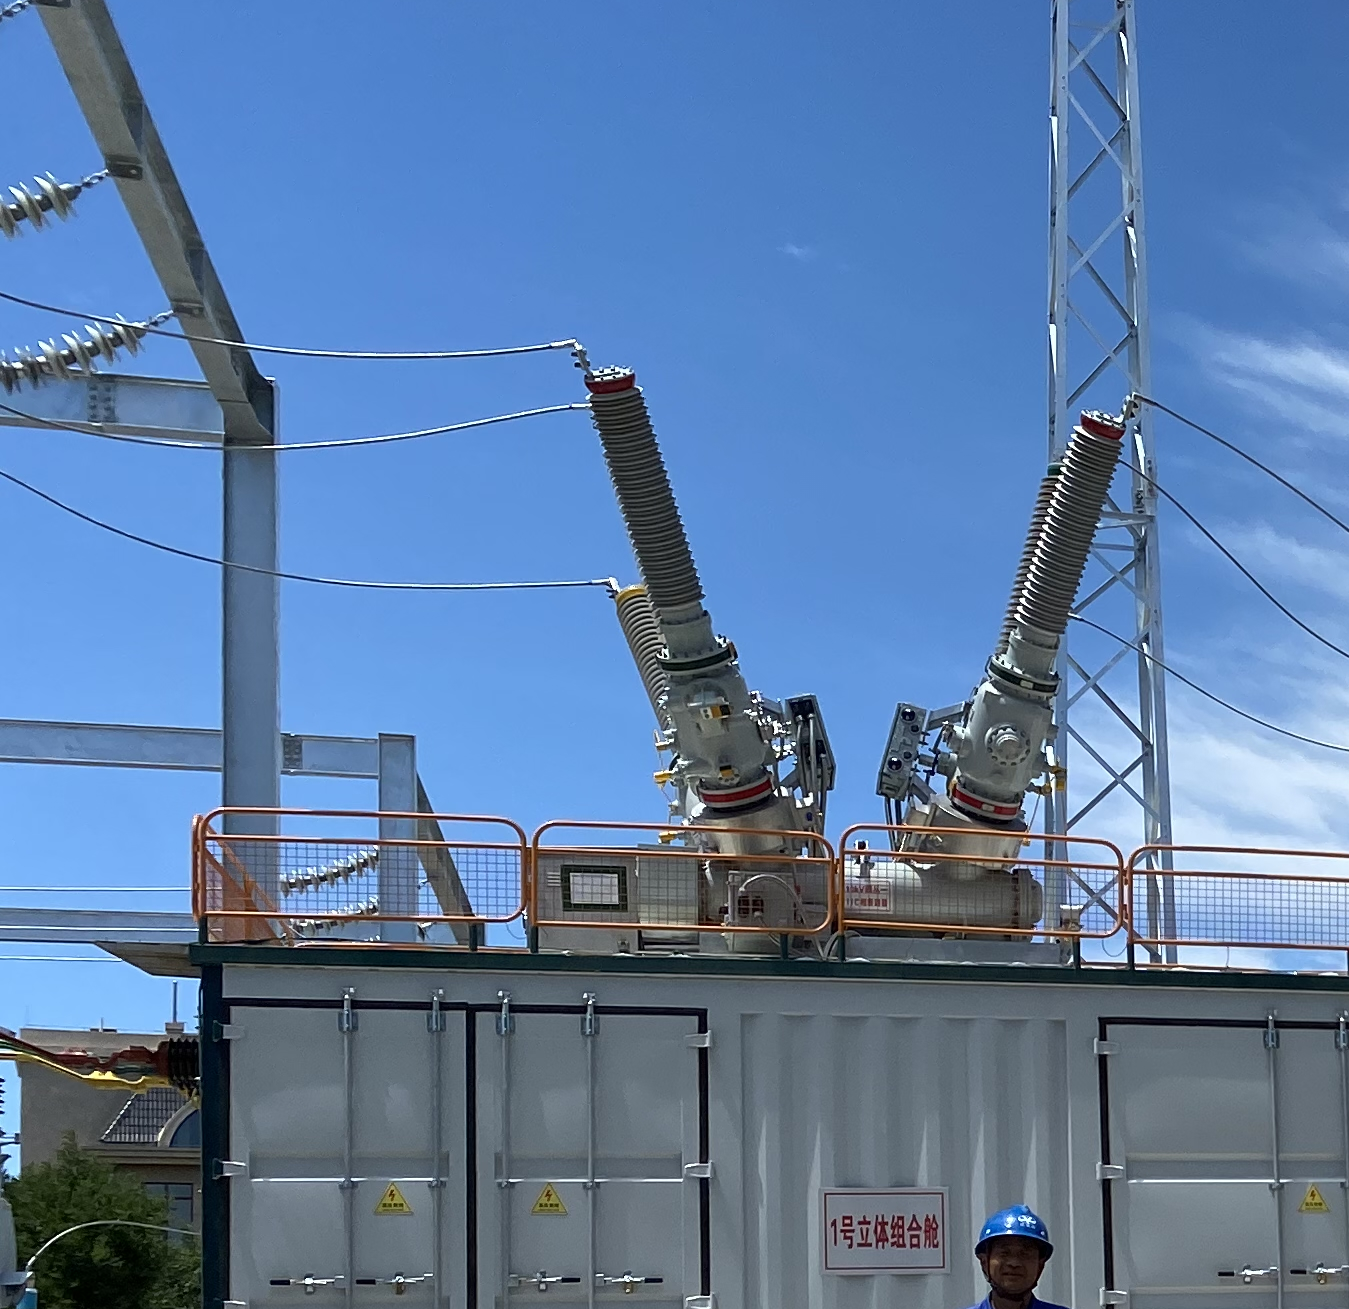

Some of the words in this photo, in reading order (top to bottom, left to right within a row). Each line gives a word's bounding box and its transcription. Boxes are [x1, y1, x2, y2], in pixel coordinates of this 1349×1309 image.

[830, 1213, 940, 1250] 1号立体组合舱
